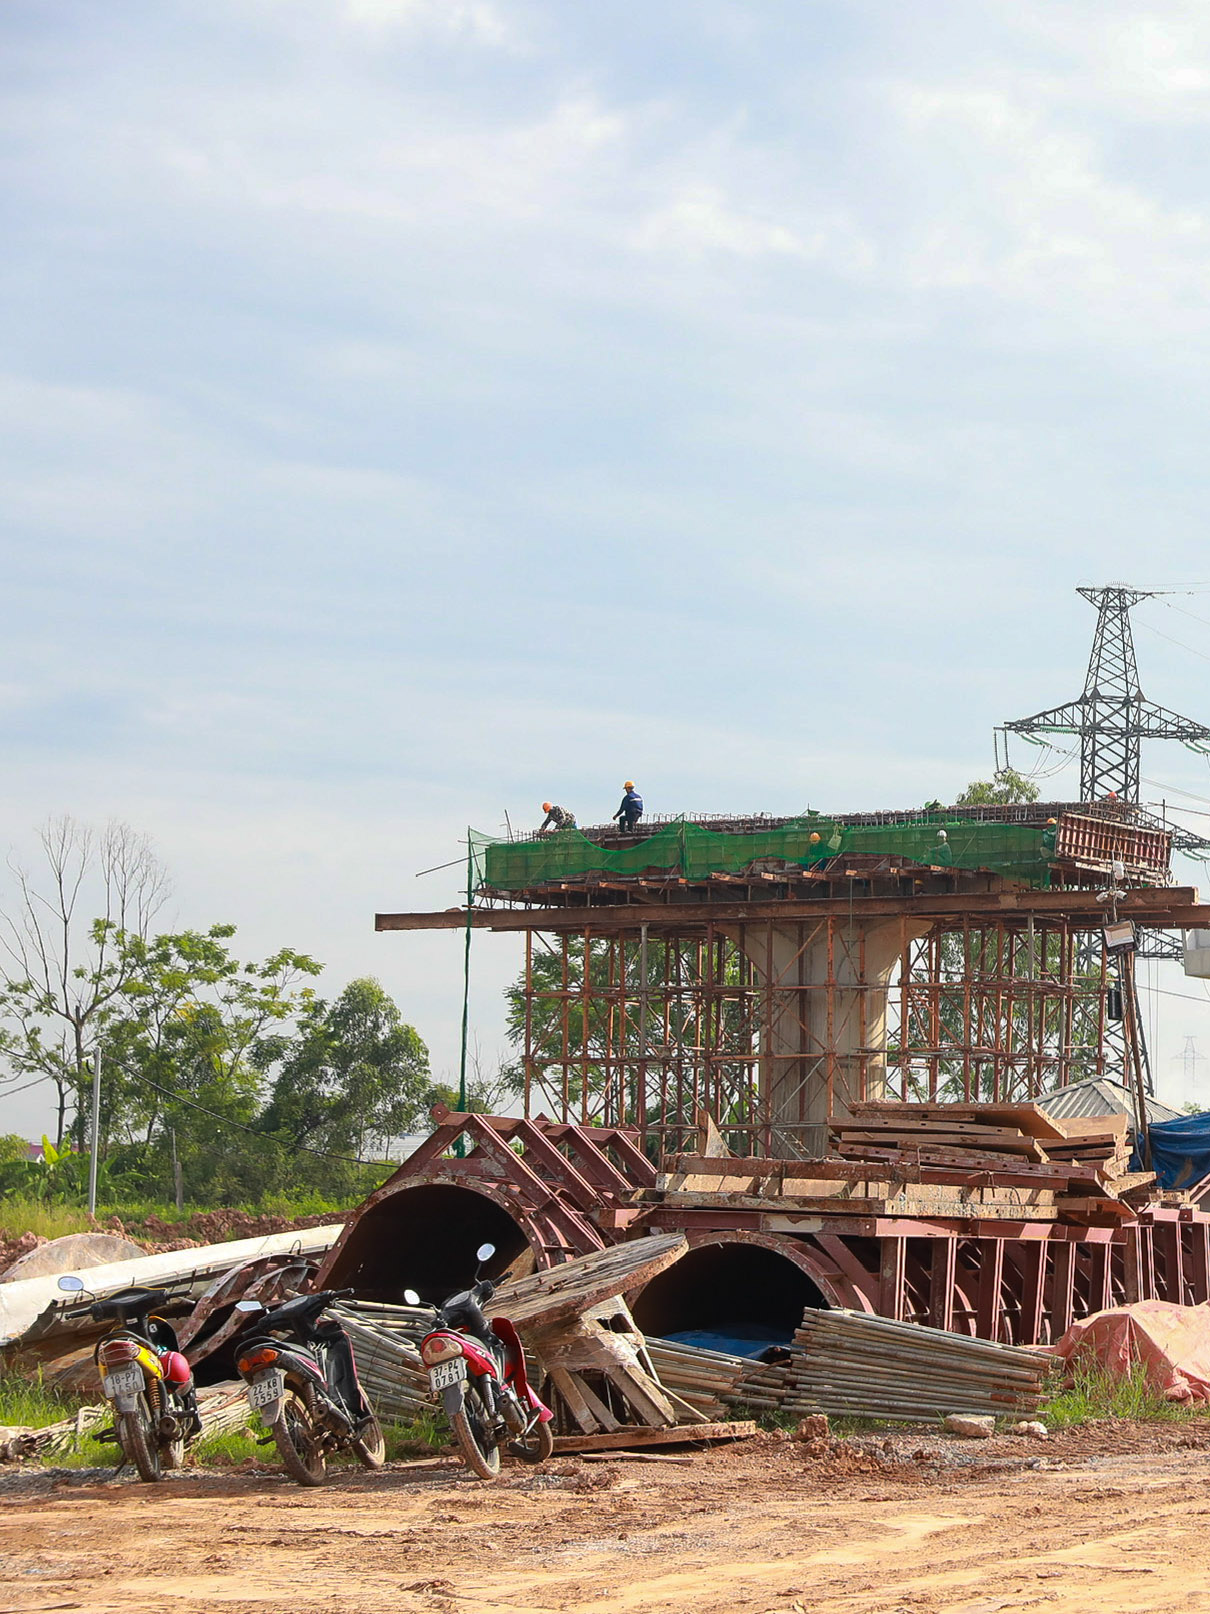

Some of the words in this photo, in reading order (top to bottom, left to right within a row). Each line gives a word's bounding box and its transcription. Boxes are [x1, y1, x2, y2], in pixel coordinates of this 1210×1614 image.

[433, 1360, 459, 1377] 37-P4
[111, 1371, 136, 1385] 18-P7
[253, 1378, 278, 1396] 22-K8
[435, 1370, 460, 1388] 0781
[254, 1388, 279, 1406] 2559
